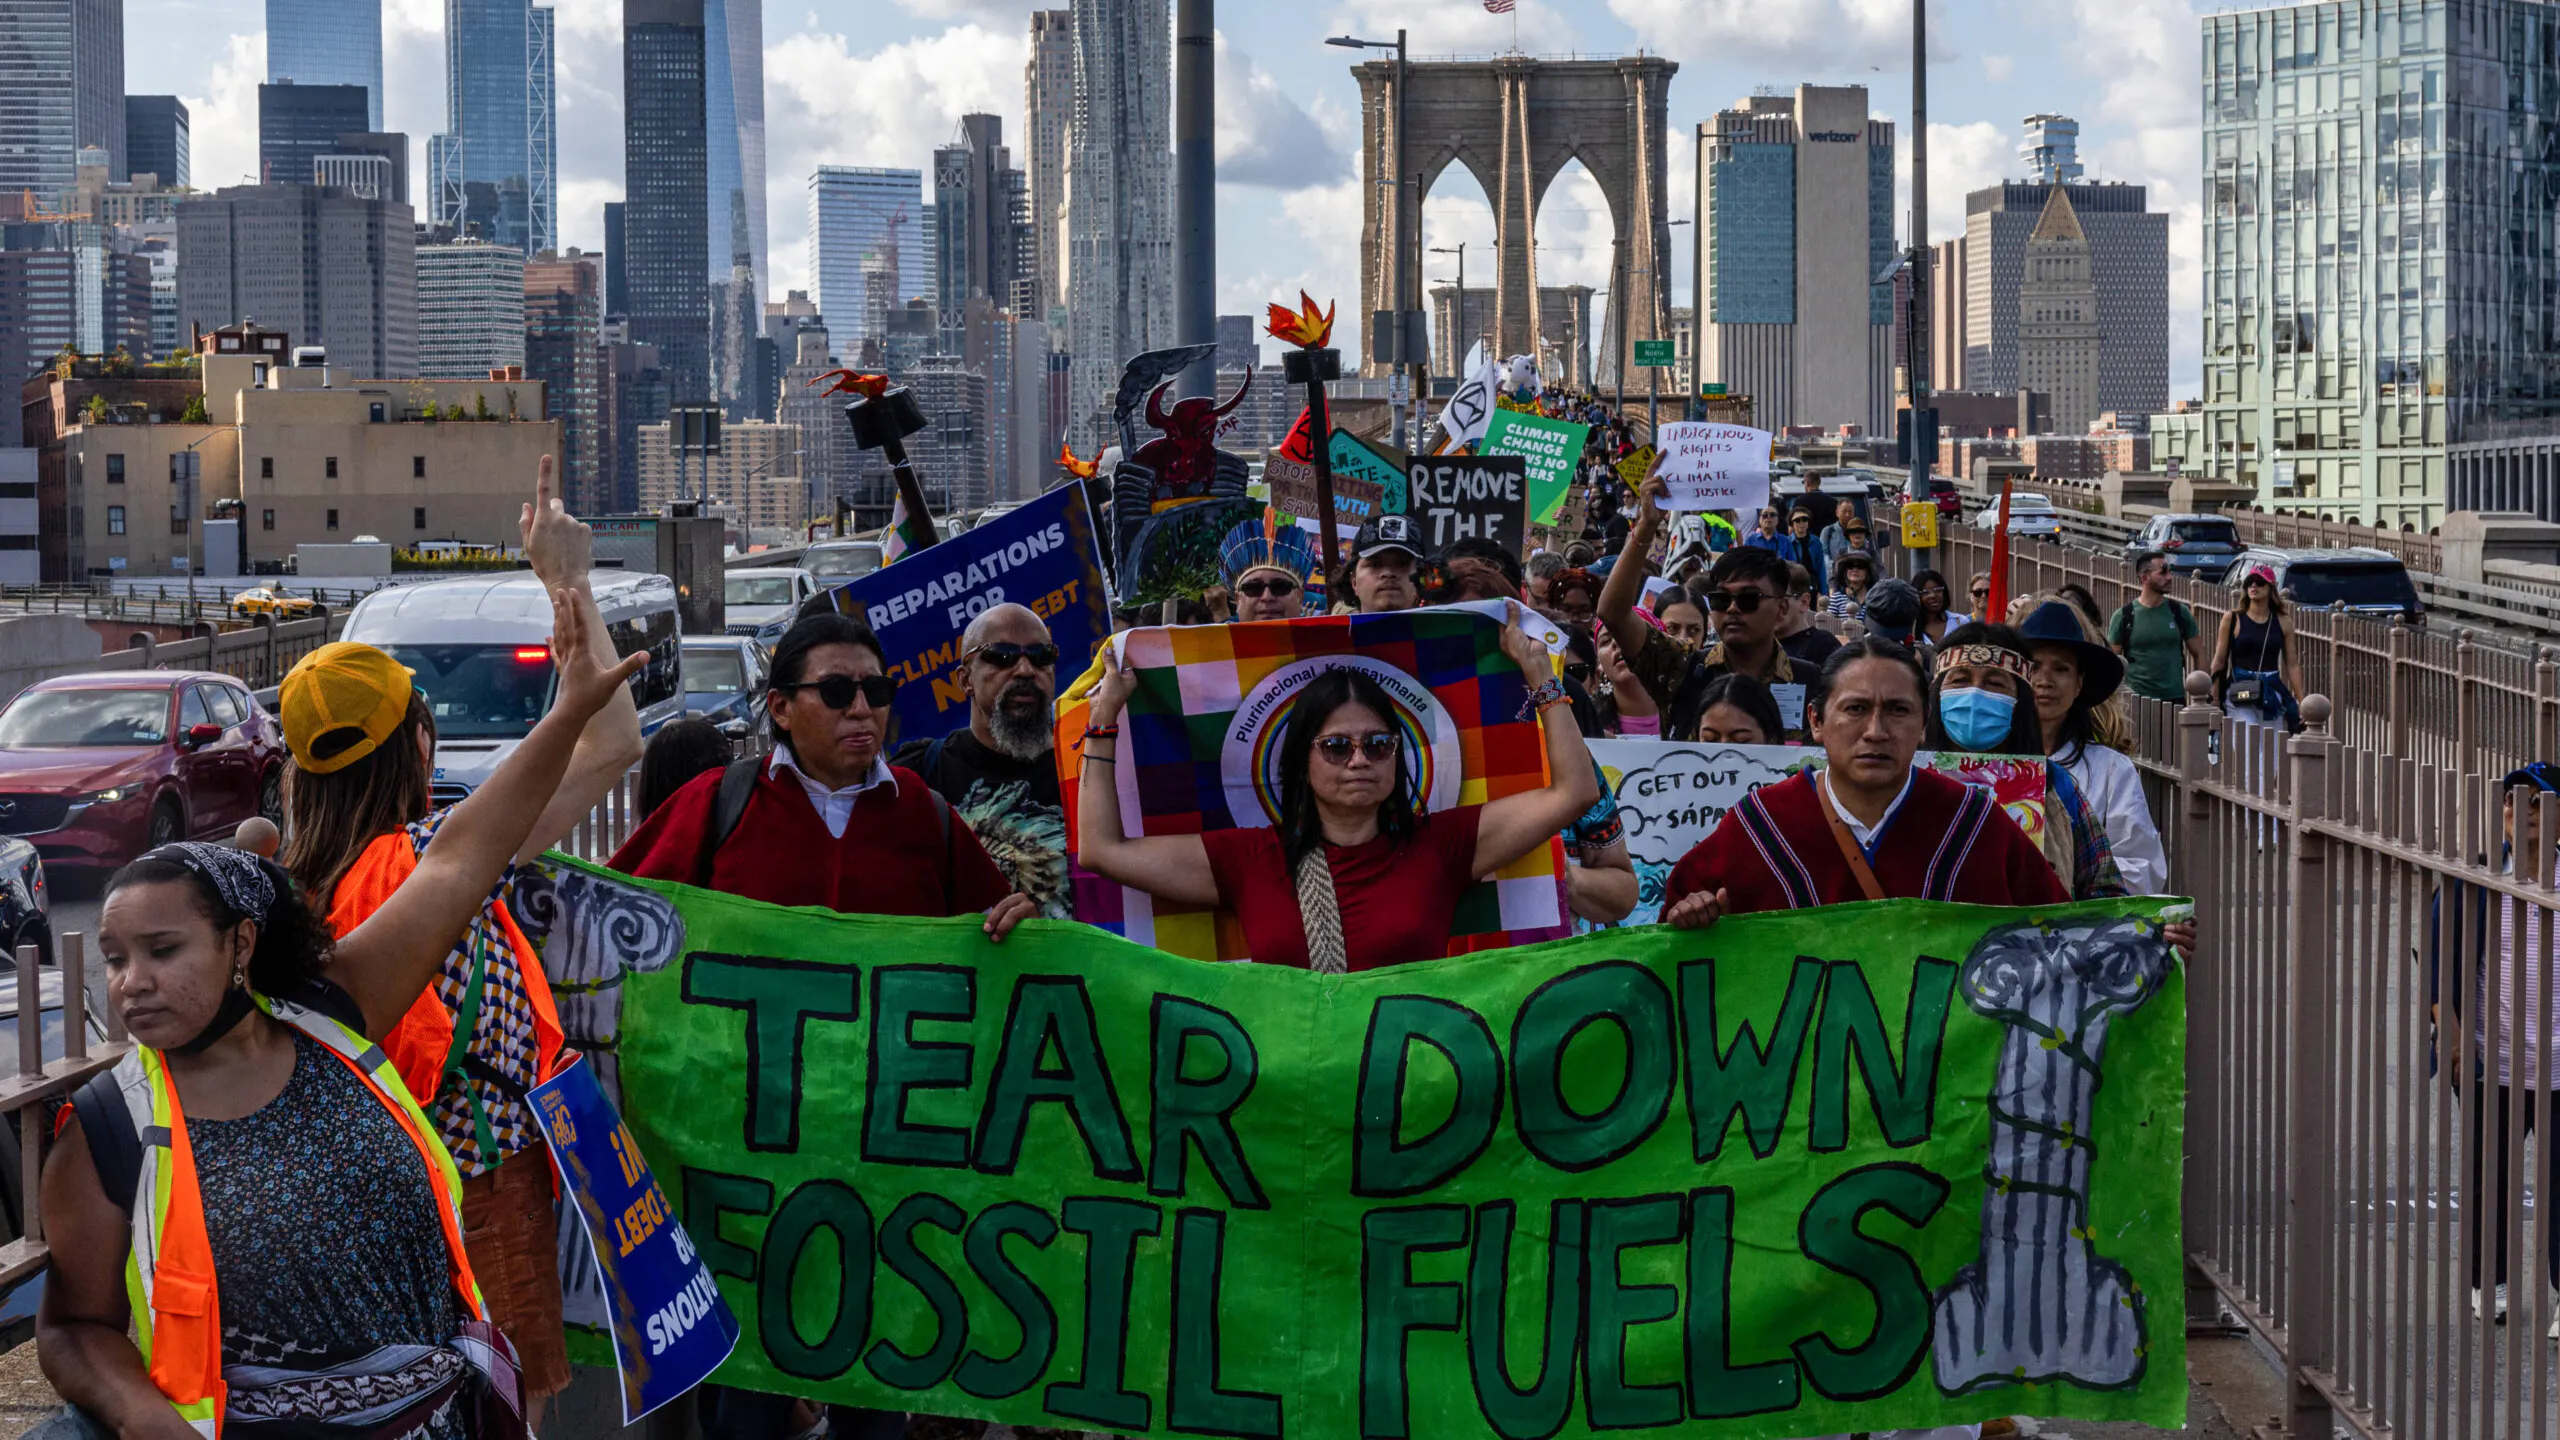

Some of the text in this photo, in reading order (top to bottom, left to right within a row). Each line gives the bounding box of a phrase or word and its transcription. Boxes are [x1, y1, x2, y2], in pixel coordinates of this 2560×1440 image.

[1808, 129, 1857, 143] verizon
[1506, 423, 1569, 444] CLIMATE
[1502, 435, 1564, 456] CHANGE
[1680, 443, 1733, 457] RIGHTS
[1268, 459, 1312, 482] STOP
[1525, 466, 1556, 482] DERS
[1544, 457, 1568, 470] NO
[1697, 460, 1709, 469] IN
[1410, 464, 1522, 510] REMOVE
[1665, 469, 1730, 483] CLIMATE
[1283, 497, 1319, 518] SAV
[1333, 494, 1371, 516] OUTH
[610, 522, 641, 530] CART
[1428, 508, 1504, 546] THE
[867, 522, 1065, 632] REPARATIONS
[948, 586, 1006, 629] FOR
[886, 578, 1079, 688] CLIM EBT
[1235, 665, 1317, 744] Plurinacional
[1638, 772, 1686, 797] GET
[1692, 769, 1741, 789] OUT
[681, 951, 1958, 1210] TEAR DOWN
[614, 1187, 665, 1258] DEBT
[646, 1260, 719, 1356] RATIONS
[681, 1160, 1951, 1440] FOSSIL FUELS
